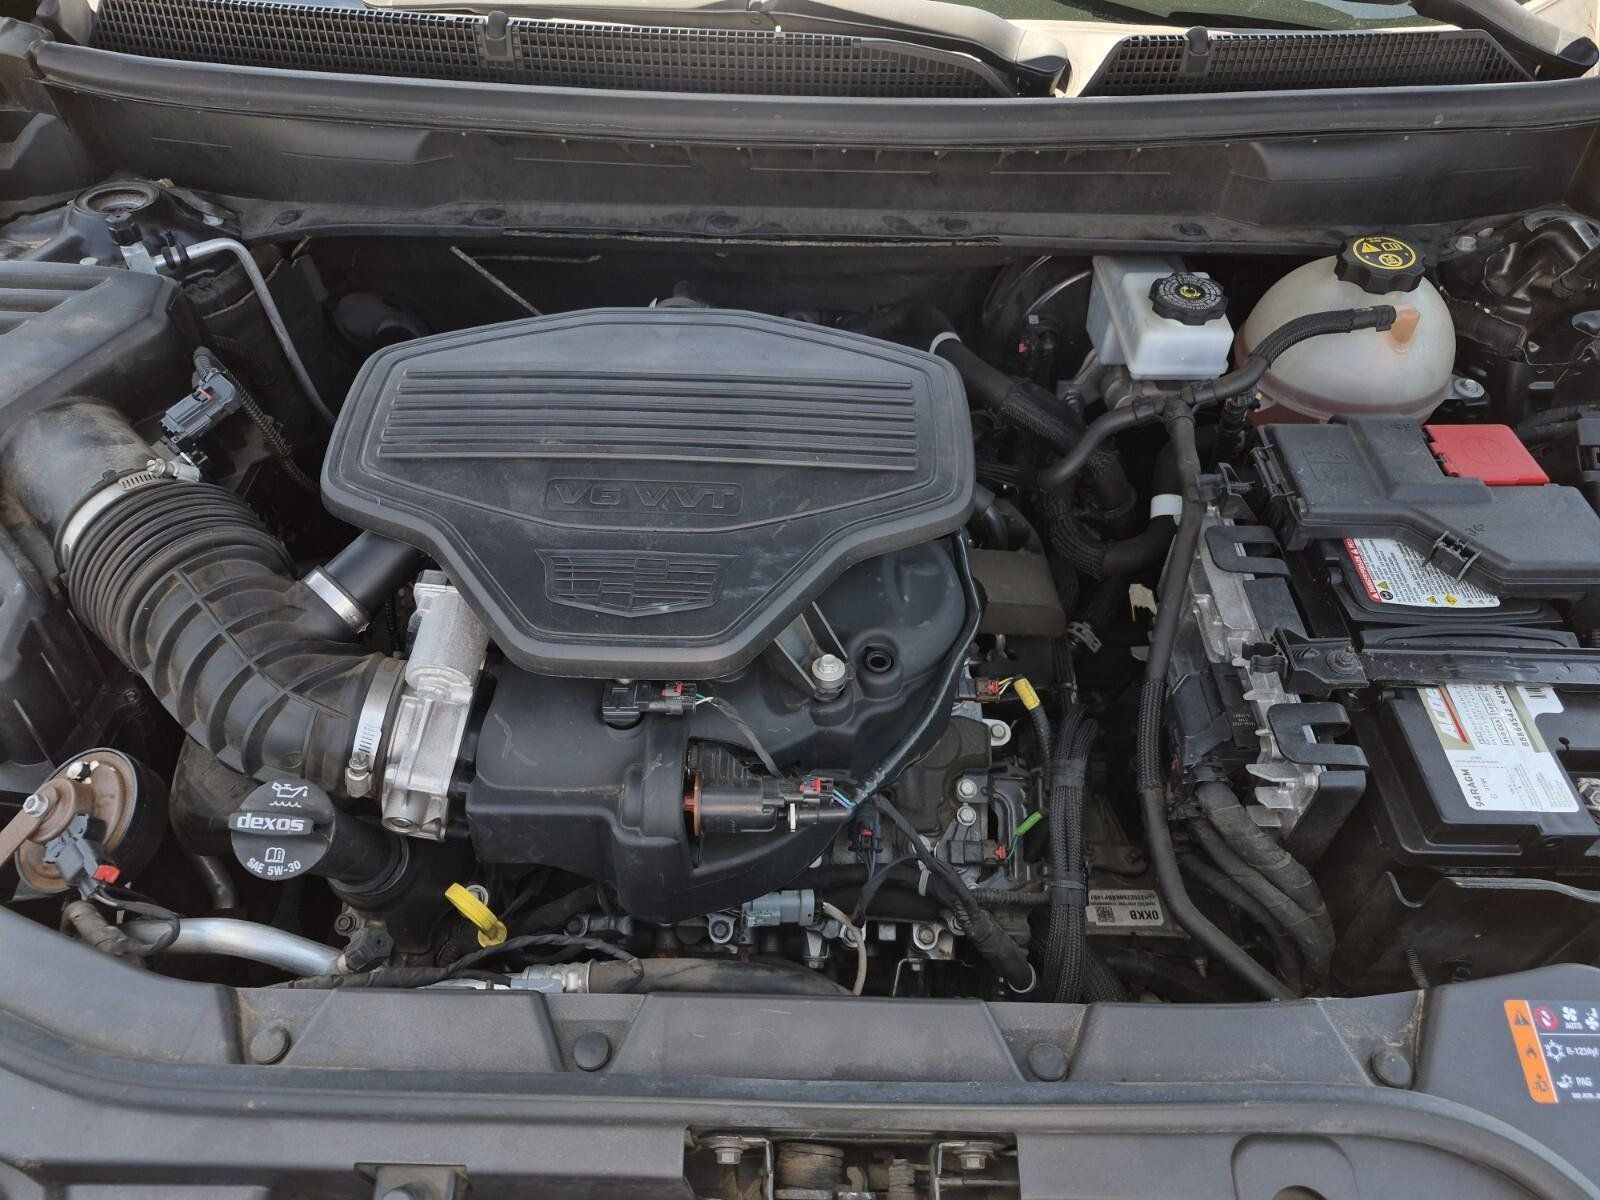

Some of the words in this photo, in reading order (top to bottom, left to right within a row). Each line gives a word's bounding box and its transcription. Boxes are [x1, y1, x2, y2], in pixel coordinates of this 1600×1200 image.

[554, 484, 621, 505] V6
[633, 486, 735, 509] VVT
[1493, 685, 1507, 704] 94RA
[1425, 688, 1460, 740] ACDe
[1461, 768, 1486, 807] 94RAGM
[237, 813, 305, 831] dexos
[246, 857, 265, 873] SAE
[267, 860, 302, 876] 5W-30
[1565, 1022, 1582, 1030] AUTO
[1575, 1076, 1593, 1087] PAG
